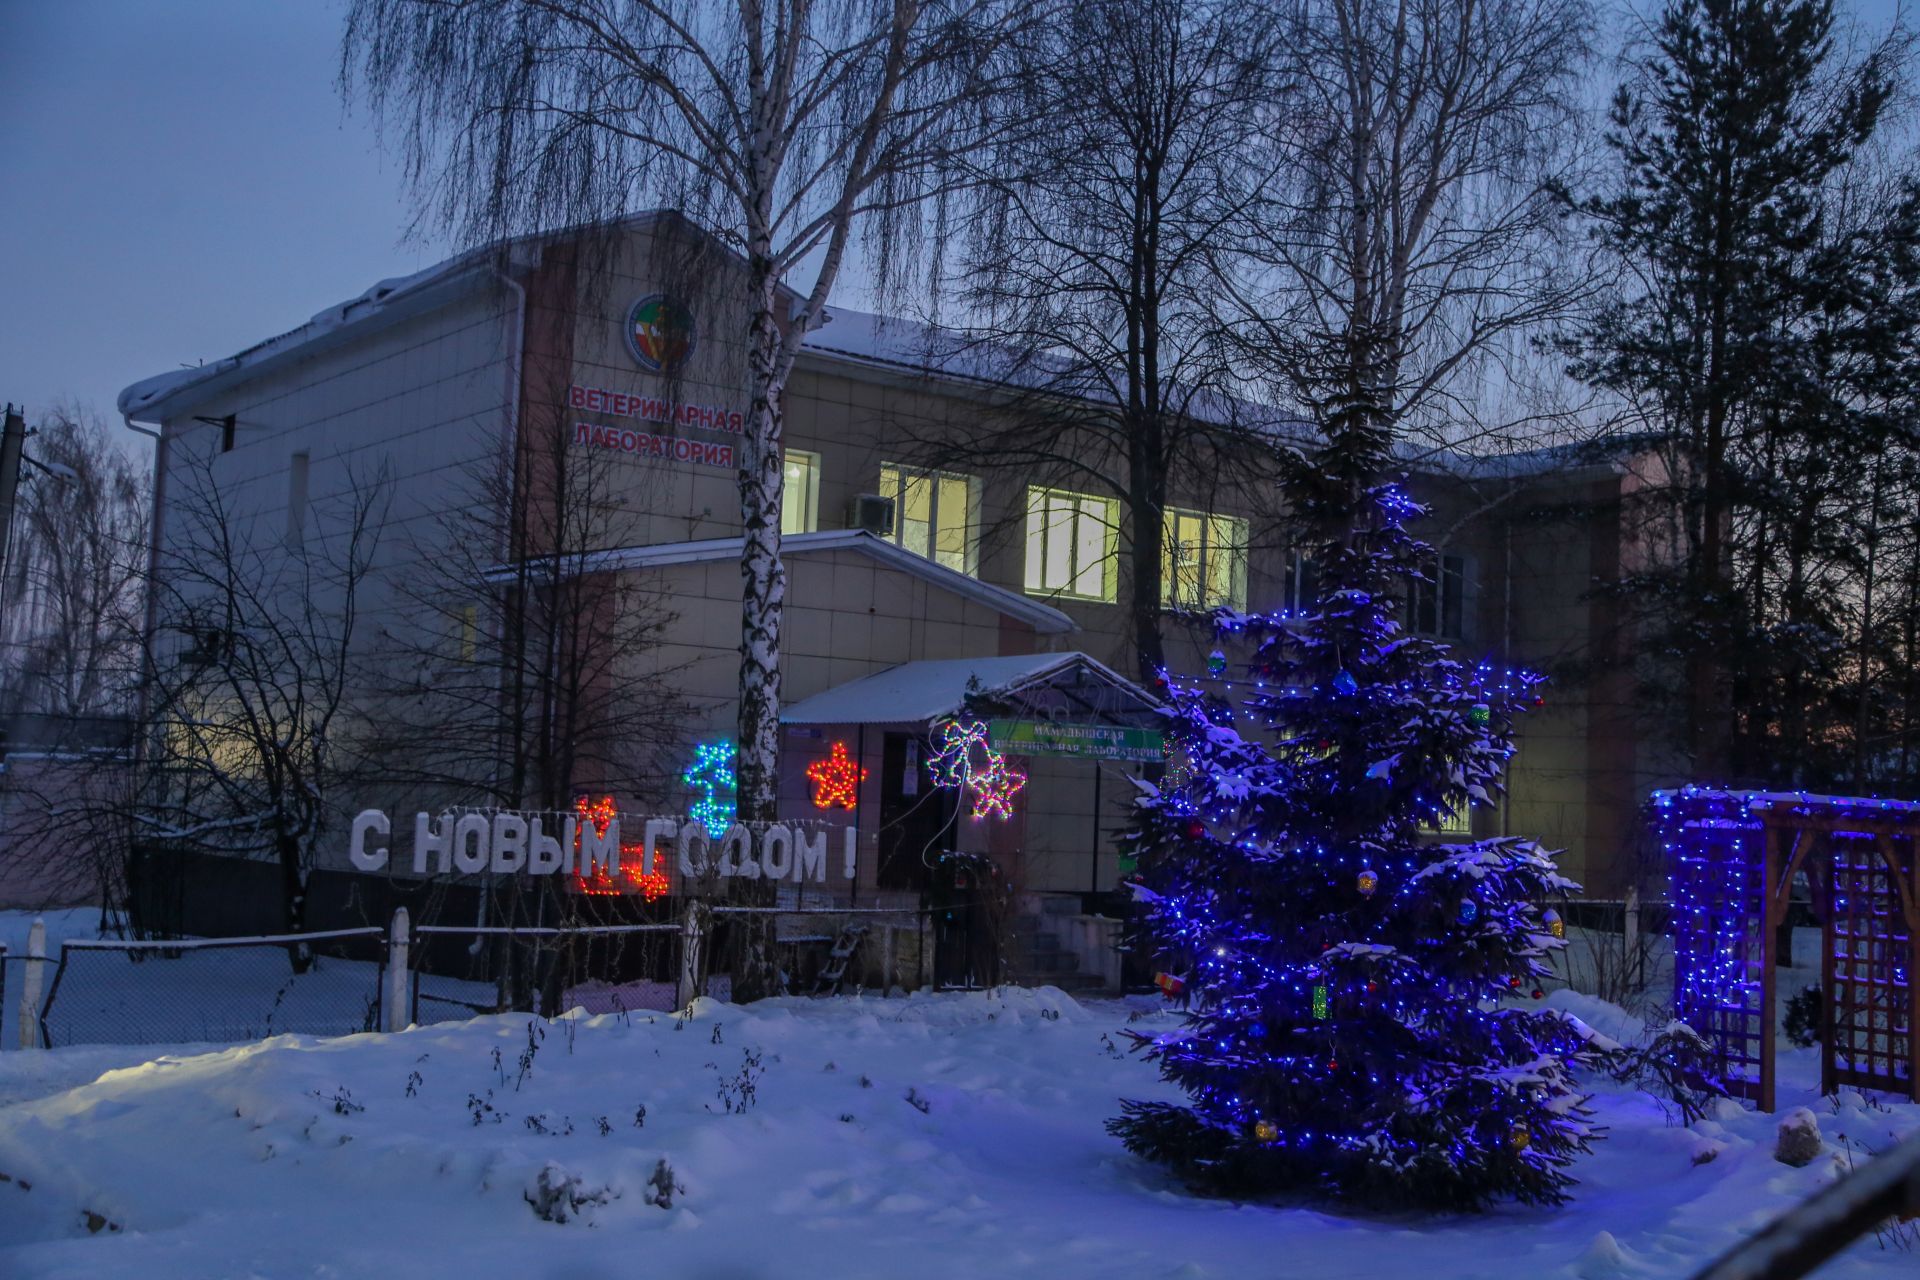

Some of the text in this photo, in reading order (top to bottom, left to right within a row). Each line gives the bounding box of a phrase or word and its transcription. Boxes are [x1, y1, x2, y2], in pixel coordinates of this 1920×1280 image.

[569, 385, 744, 434] ВЕТЕРИНАРНАЯ
[575, 423, 733, 467] ЛАБОРАТОРИЯ
[1034, 725, 1124, 741] МАМАДЫШСКАЯ
[350, 809, 390, 871] С
[414, 811, 620, 877] НОВЫМ
